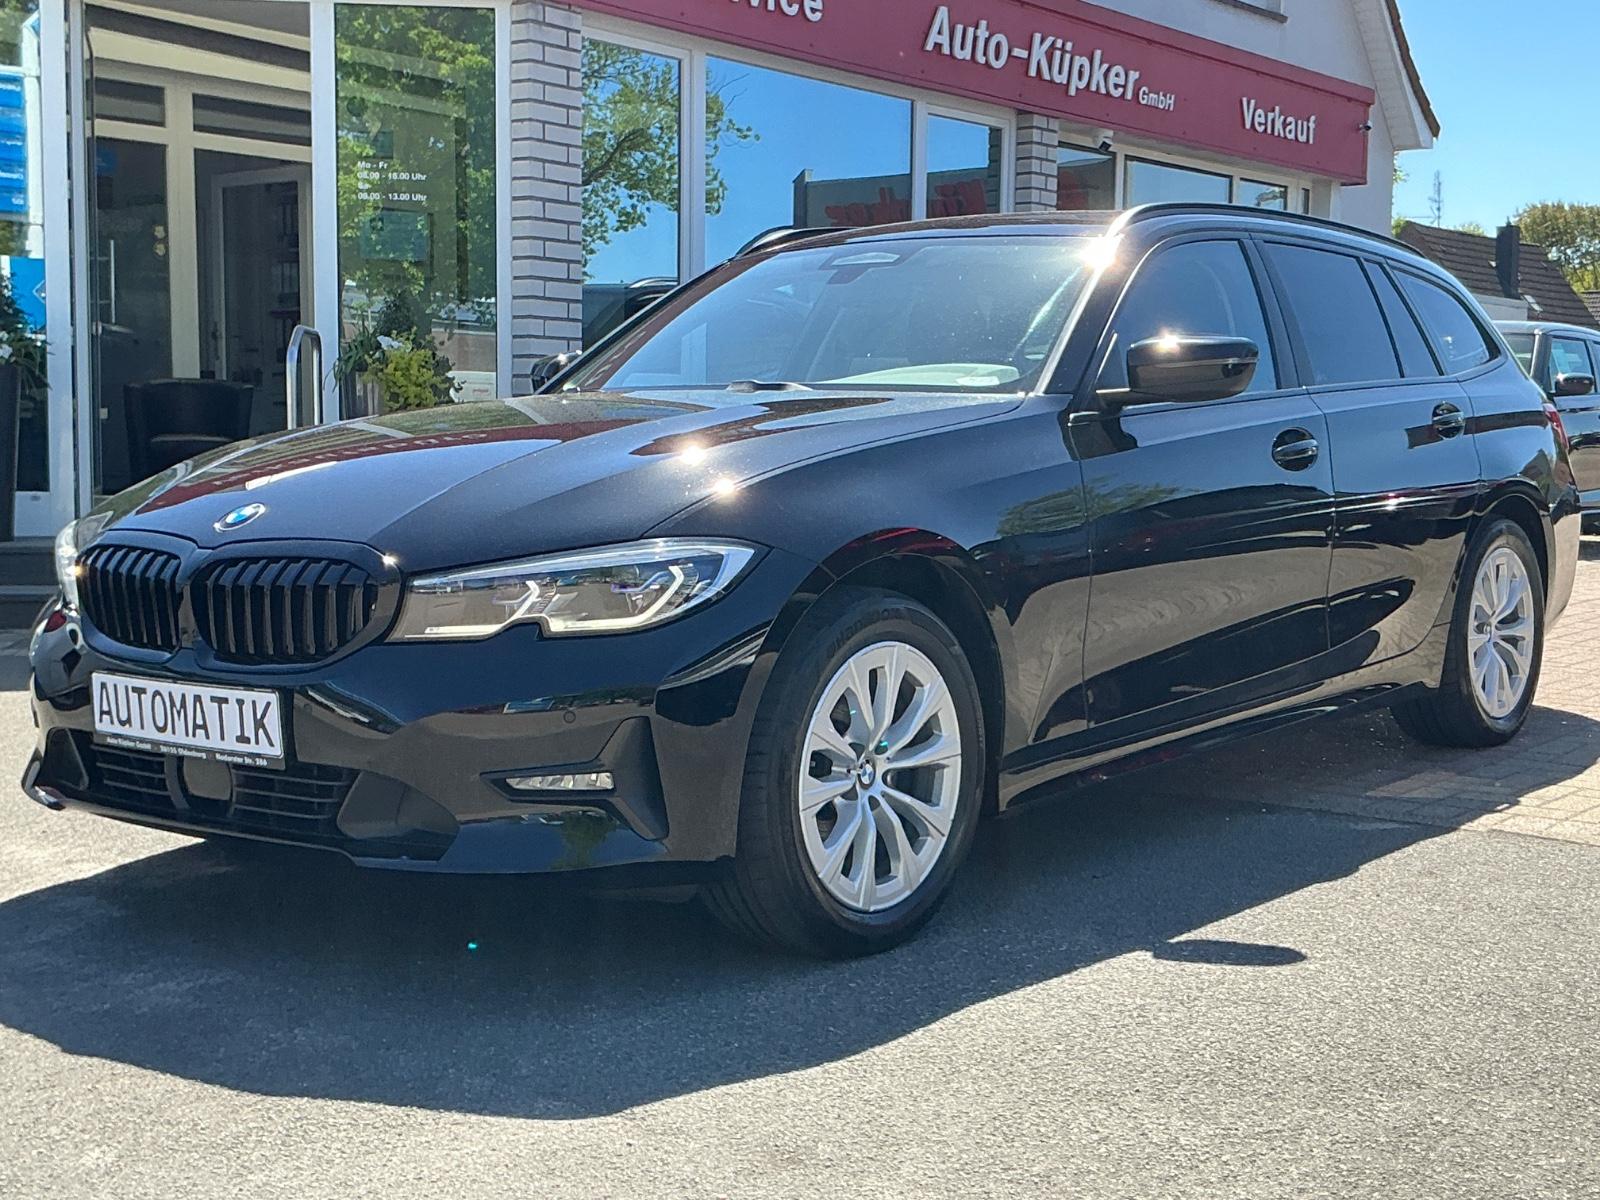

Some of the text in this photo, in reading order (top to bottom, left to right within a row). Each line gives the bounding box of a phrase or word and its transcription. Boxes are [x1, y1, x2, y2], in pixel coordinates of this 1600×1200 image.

[924, 5, 1175, 112] Auto-Küpker GmbH
[1241, 97, 1316, 144] Verkauf
[357, 161, 371, 169] Mo
[379, 161, 388, 170] Fr
[411, 173, 427, 181] Uhr
[411, 193, 427, 202] Uhr
[99, 681, 275, 748] AUTOMATIK
